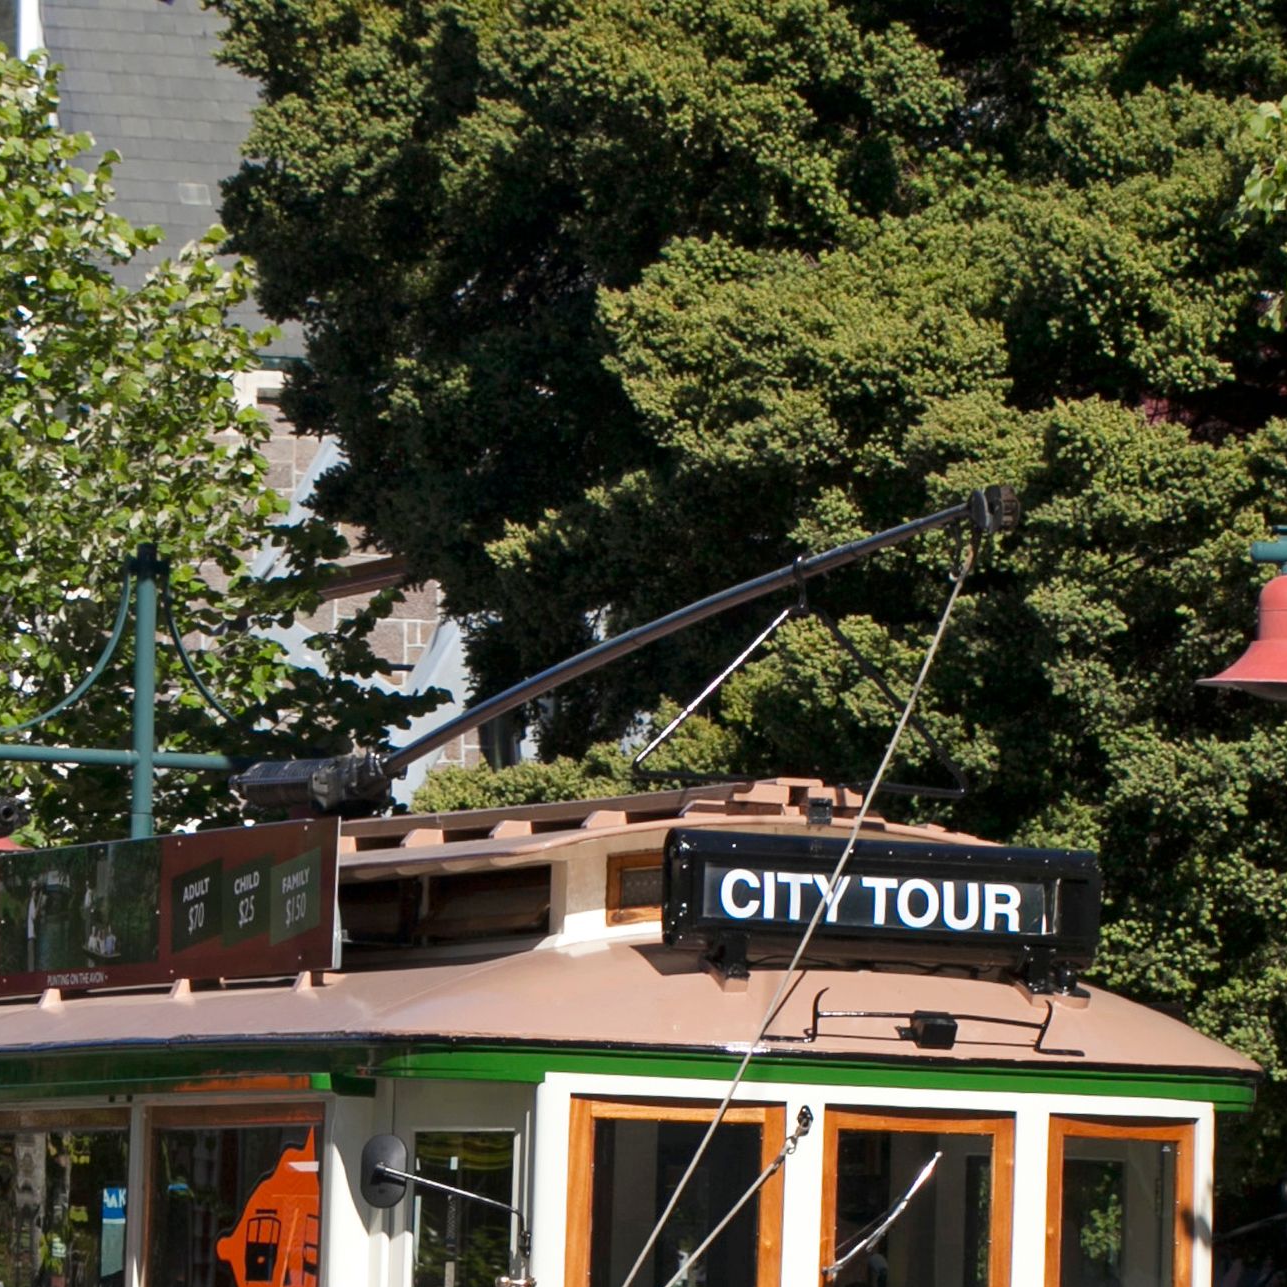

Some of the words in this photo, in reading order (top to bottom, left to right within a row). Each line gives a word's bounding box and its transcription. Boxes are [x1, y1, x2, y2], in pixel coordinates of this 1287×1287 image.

[183, 877, 210, 904] ADULT
[234, 870, 259, 894] CHILD
[281, 867, 310, 894] FAMILY
[239, 895, 255, 928] $25
[286, 897, 307, 928] $150
[720, 868, 850, 924] CITY
[860, 875, 1021, 933] TOUR
[188, 902, 205, 936] $70
